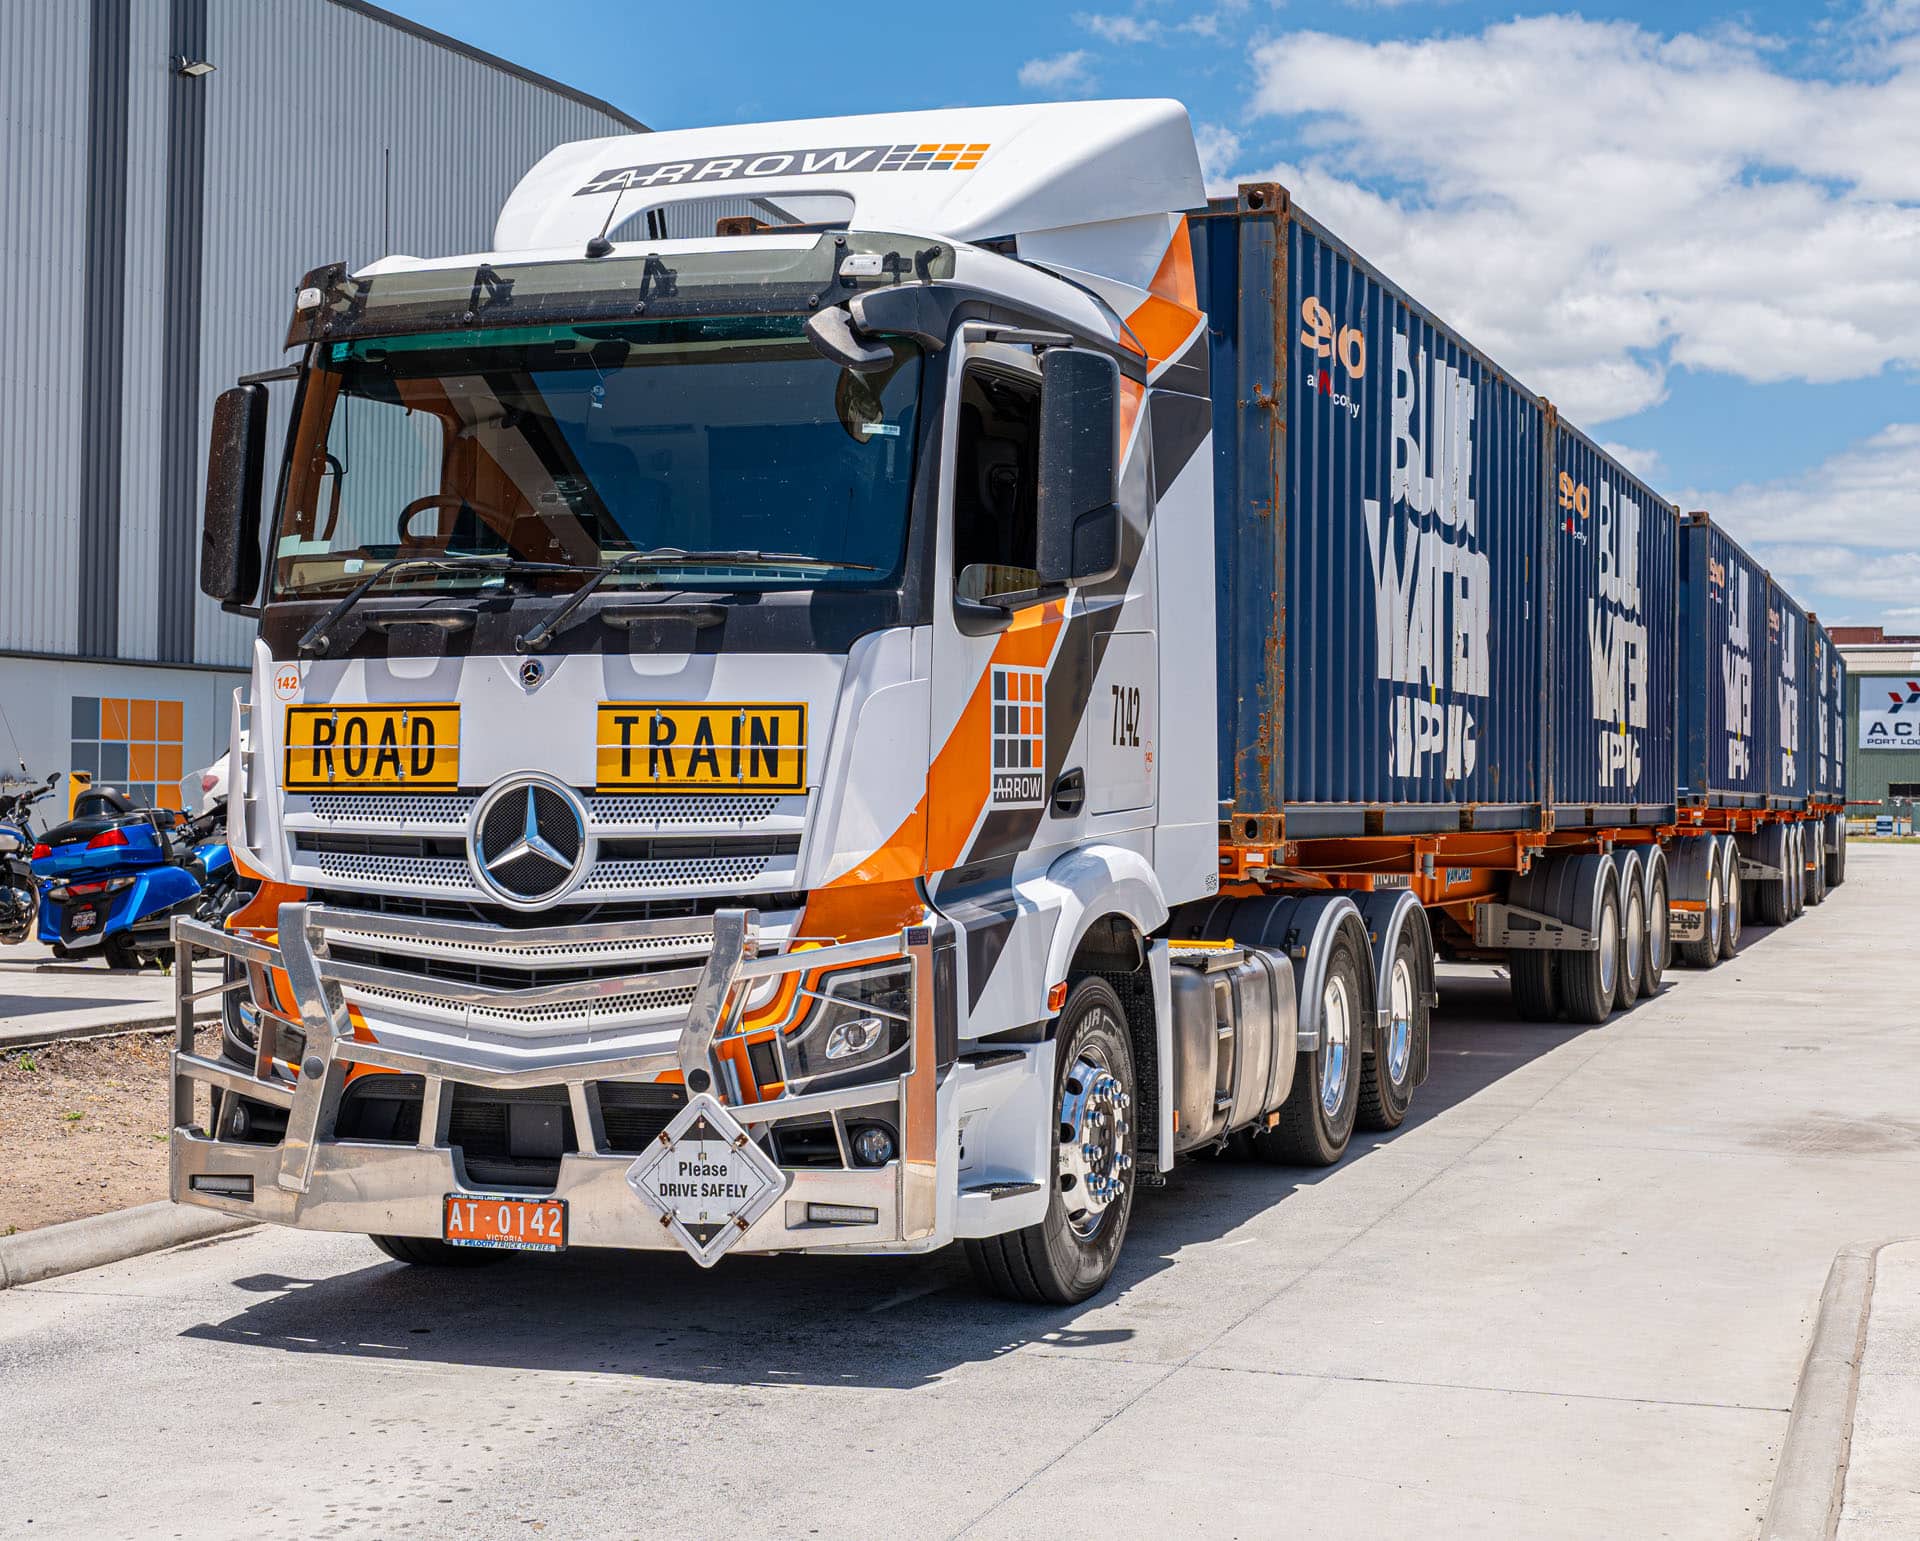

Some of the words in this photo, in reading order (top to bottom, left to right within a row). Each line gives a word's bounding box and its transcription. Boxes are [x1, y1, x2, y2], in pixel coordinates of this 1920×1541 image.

[591, 150, 876, 193] ARROW
[277, 677, 297, 689] 142
[1112, 685, 1140, 747] 7142
[1868, 721, 1920, 736] AC
[313, 717, 435, 777] ROAD
[614, 716, 779, 777] TRAIN
[994, 777, 1041, 799] ARROW
[679, 1161, 727, 1177] Please
[660, 1183, 698, 1197] DRIVE
[701, 1183, 748, 1198] SAFELY
[486, 1233, 522, 1242] VICTORIA
